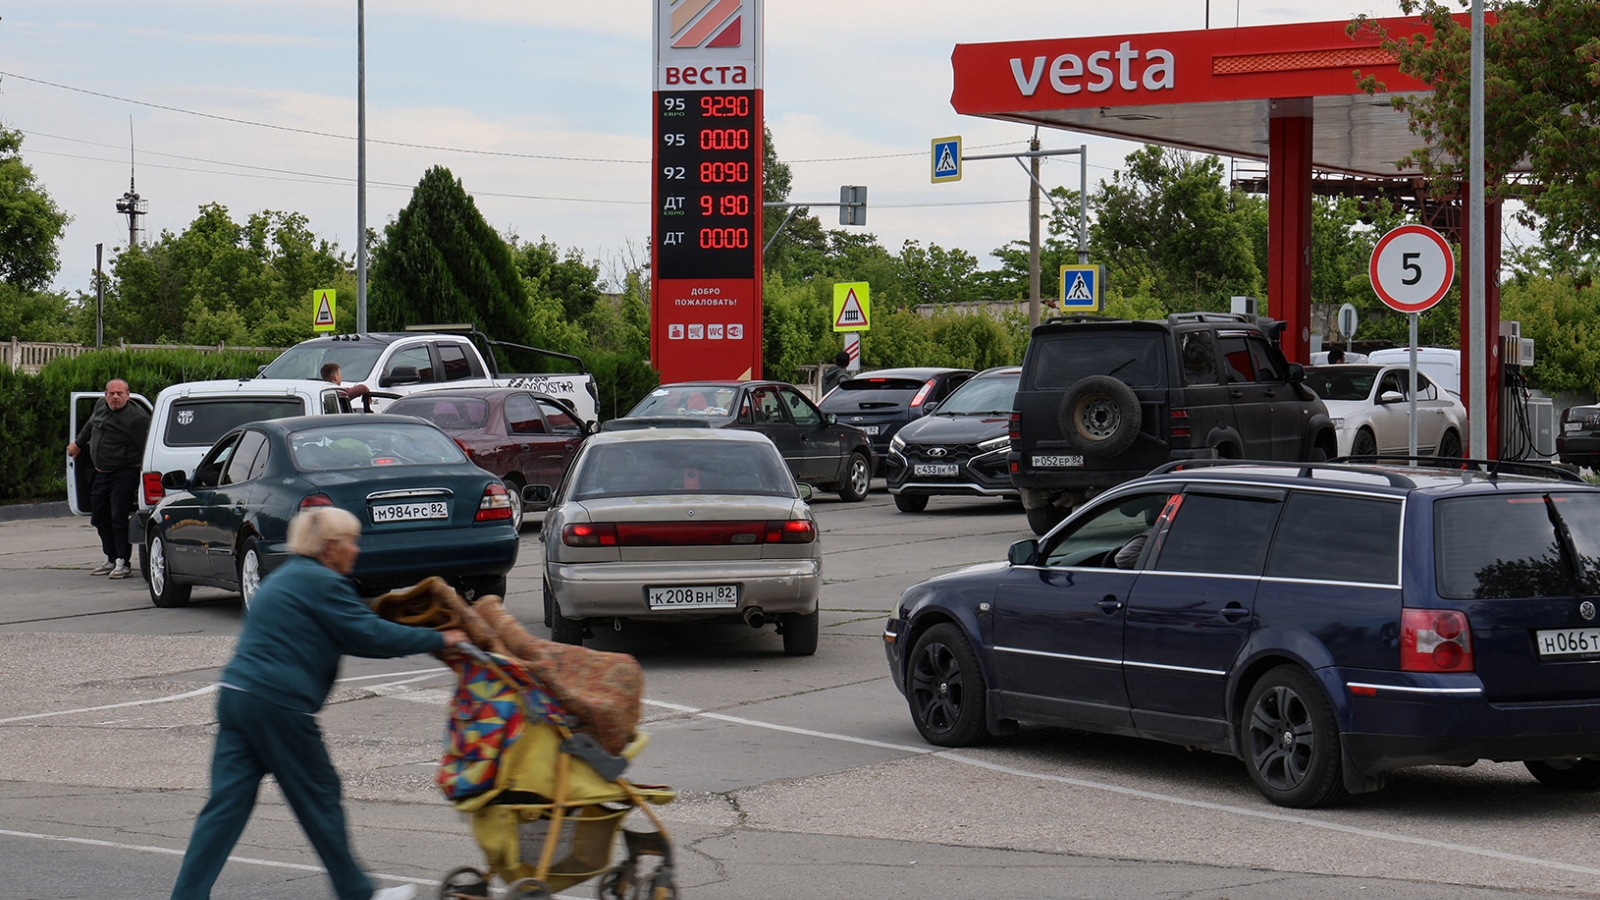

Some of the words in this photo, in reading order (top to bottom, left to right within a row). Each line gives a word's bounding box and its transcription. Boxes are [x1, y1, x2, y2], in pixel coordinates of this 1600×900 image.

[665, 65, 747, 85] веста
[1009, 40, 1175, 96] vesta
[664, 97, 686, 111] 95
[700, 95, 749, 117] 92.90
[664, 133, 686, 147] 95
[663, 166, 686, 180] 92
[664, 196, 686, 210] ДТ
[663, 231, 685, 246] ДТ
[1401, 252, 1422, 286] 5
[690, 287, 721, 296] ДОБРО
[674, 298, 737, 306] ПОЖАЛОВАТЬ!
[708, 327, 723, 336] WC
[1071, 455, 1082, 463] 82
[430, 503, 443, 513] 82
[717, 587, 732, 598] 82
